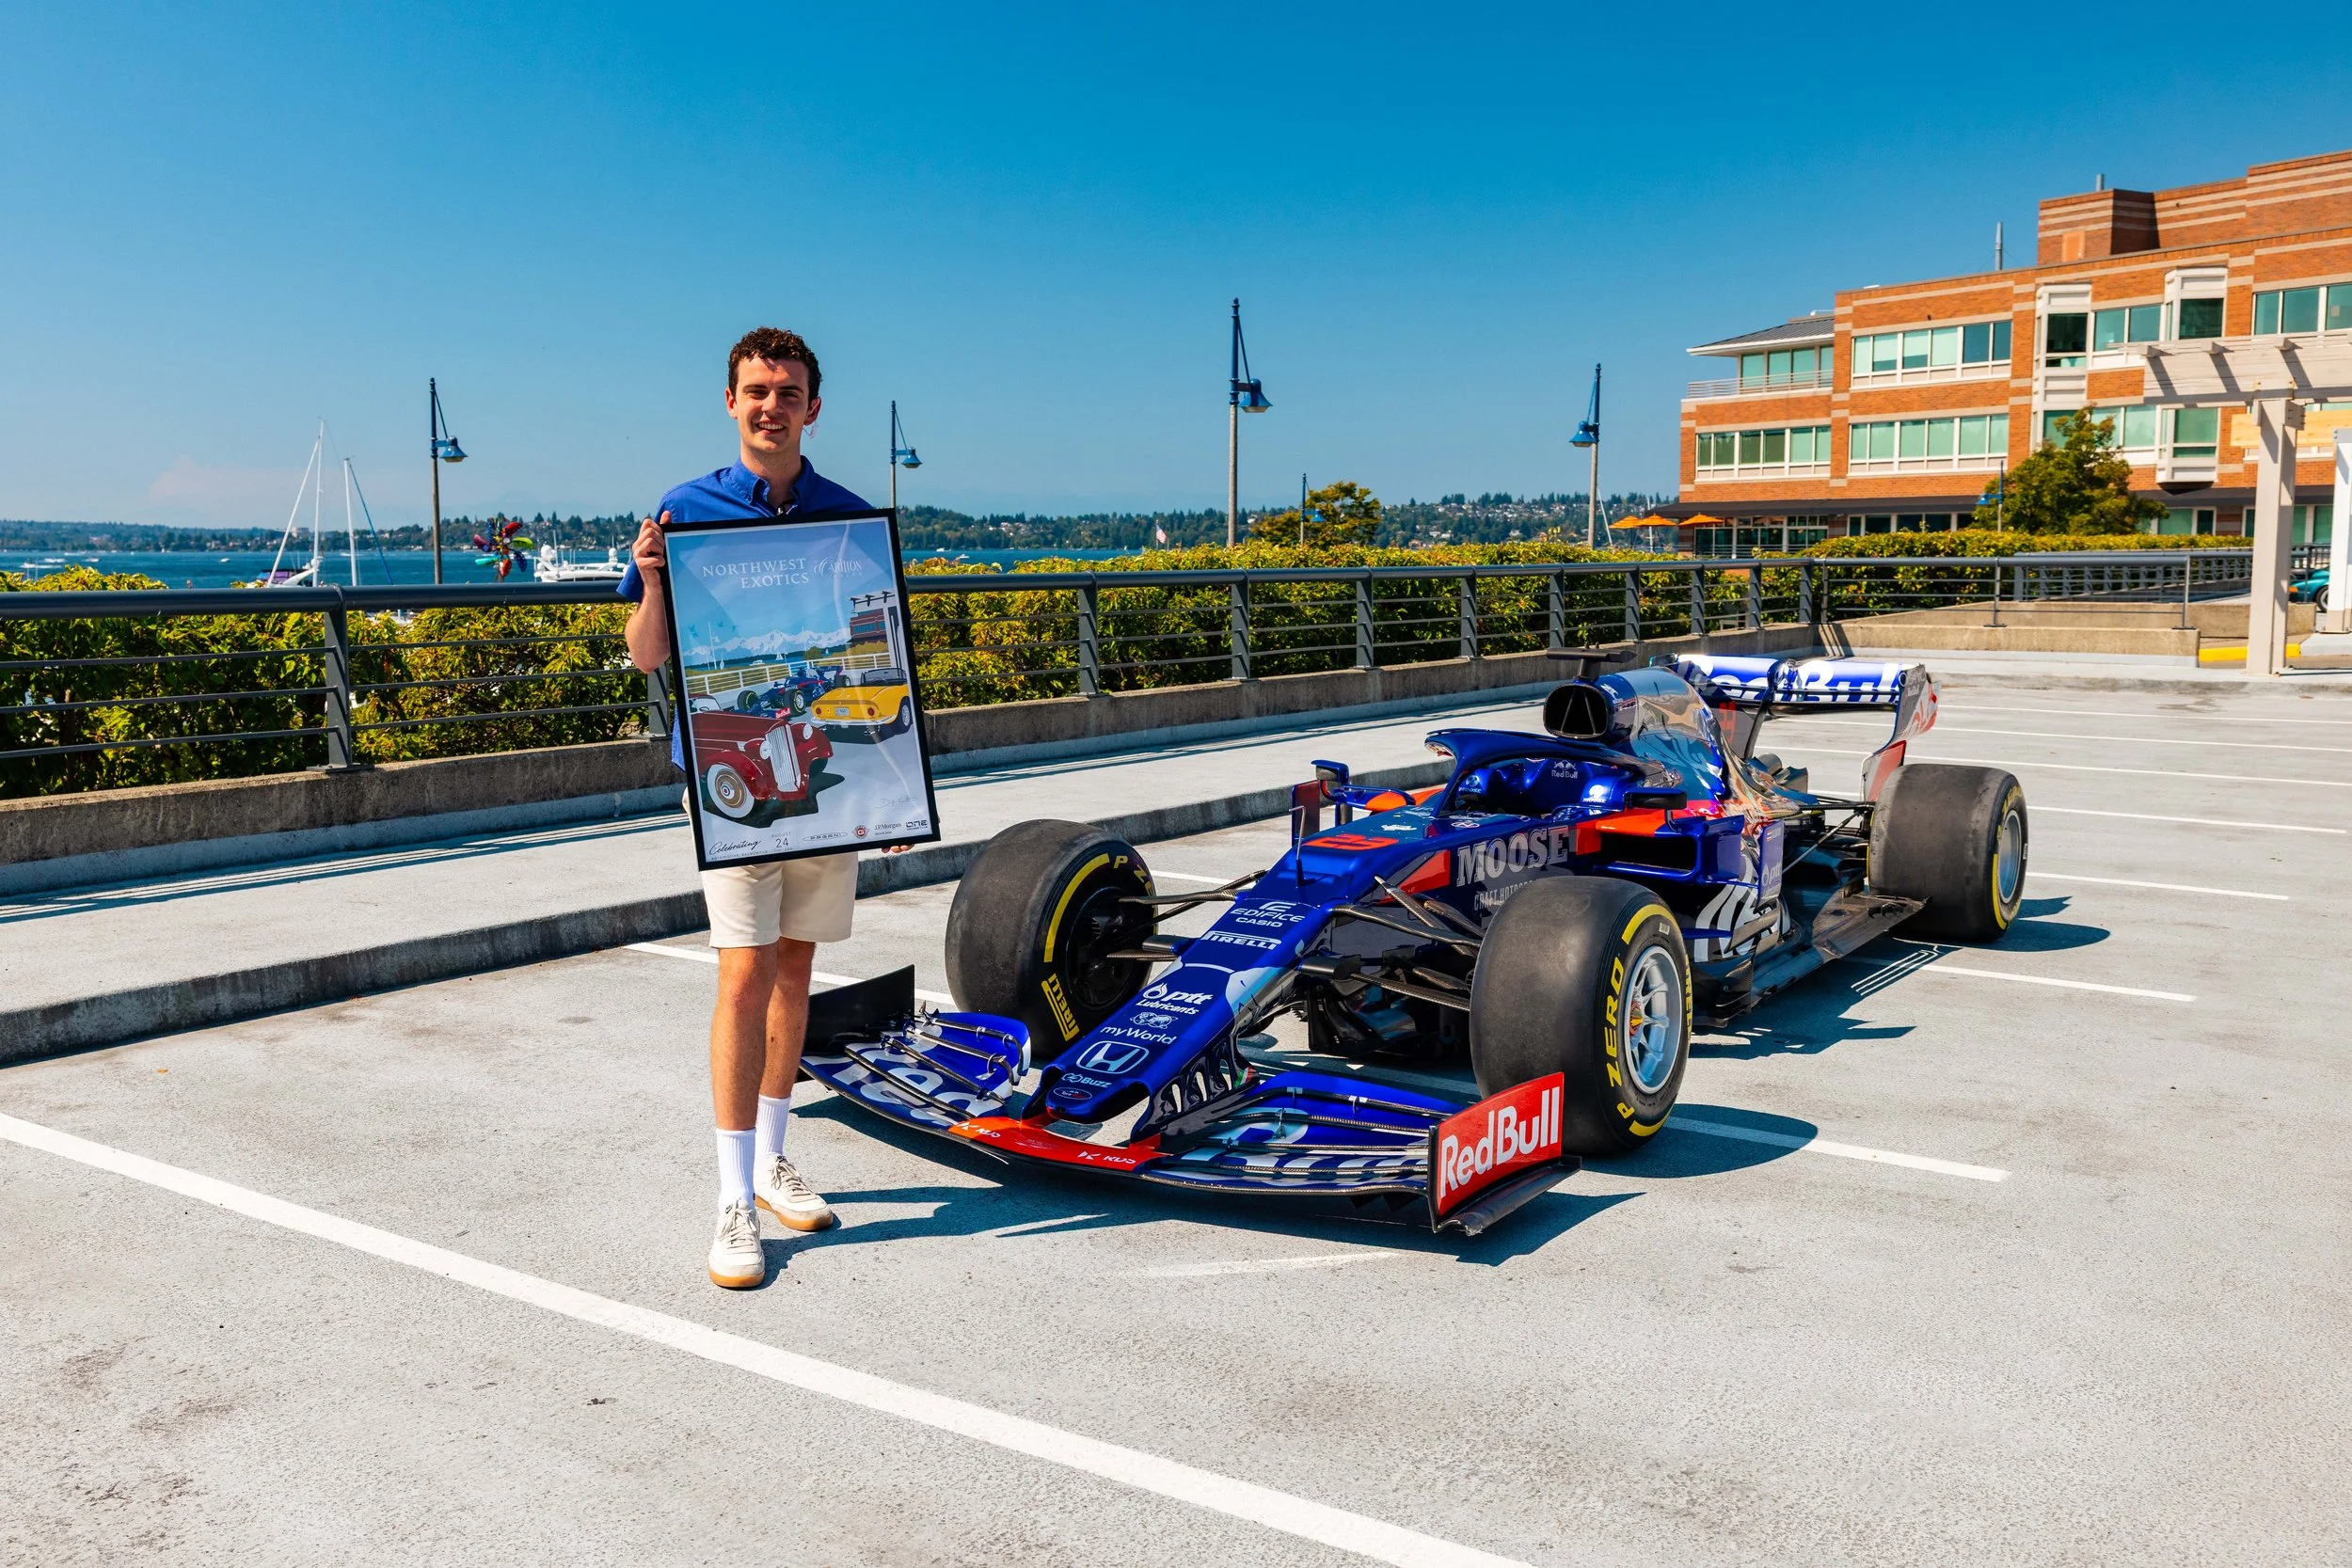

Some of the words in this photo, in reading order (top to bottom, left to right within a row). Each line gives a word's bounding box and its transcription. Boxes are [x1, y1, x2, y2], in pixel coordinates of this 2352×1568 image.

[702, 558, 806, 578] NORTHWEST
[740, 572, 809, 589] EXOTICS
[1551, 769, 1565, 778] Red
[1565, 770, 1579, 779] Bull
[709, 840, 762, 856] Celebrating
[775, 837, 789, 848] 24
[1113, 855, 1128, 869] P
[1456, 825, 1569, 888] MOOSE
[1474, 889, 1498, 911] CRAFT
[1230, 908, 1306, 923] EDIFICE
[1235, 917, 1283, 927] CASIO
[1200, 930, 1282, 950] PIRELLI
[1162, 990, 1214, 1006] ptt
[1041, 973, 1080, 1042] PIRELLI
[1135, 999, 1200, 1015] Lubricants
[1605, 957, 1625, 1087] ZERO
[1082, 1077, 1113, 1088] BUZZ
[1617, 1102, 1634, 1118] P
